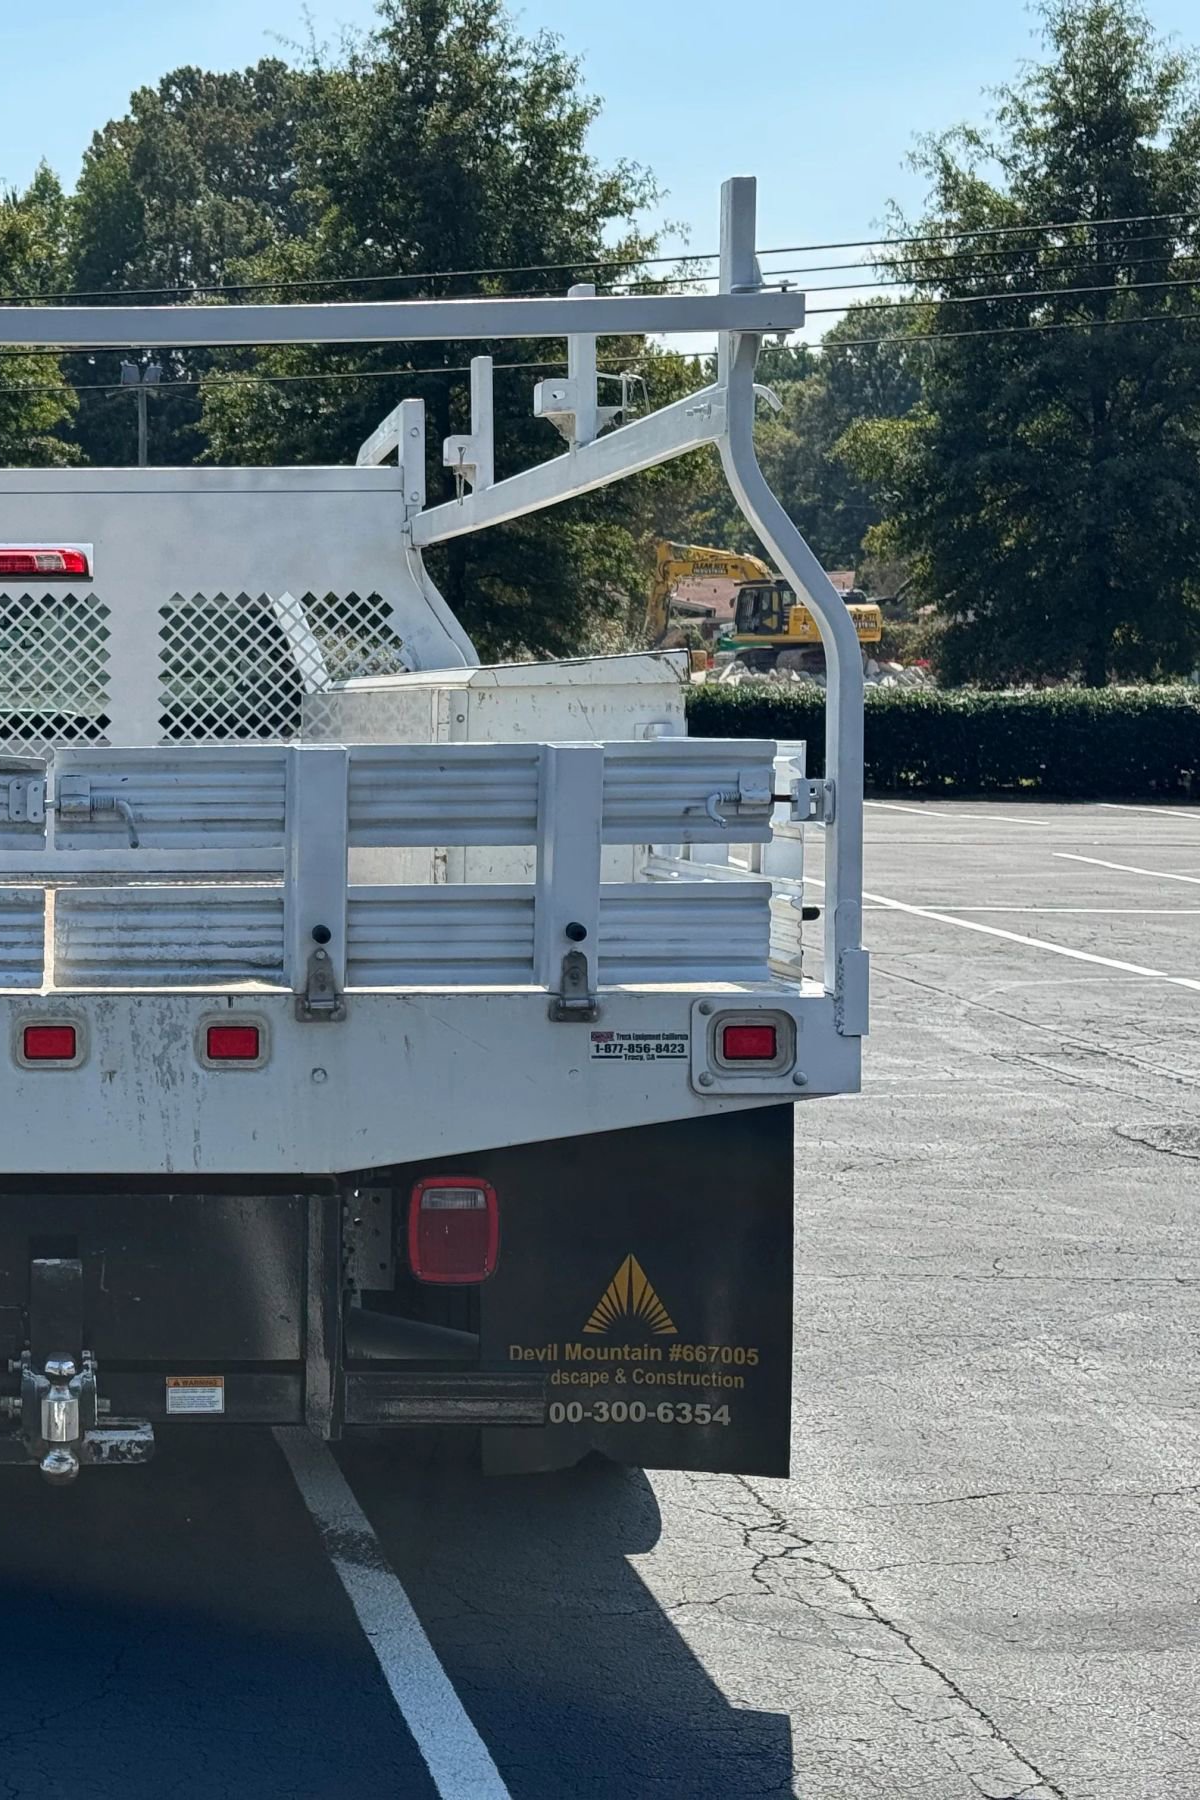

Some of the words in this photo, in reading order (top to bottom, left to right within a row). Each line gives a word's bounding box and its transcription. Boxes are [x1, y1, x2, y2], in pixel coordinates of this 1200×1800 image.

[594, 1043, 685, 1054] 1-877-856-8423
[509, 1343, 558, 1361] Devil
[565, 1342, 662, 1362] Mountain
[668, 1344, 760, 1366] #667005
[615, 1368, 628, 1385] &
[632, 1368, 745, 1389] Construction
